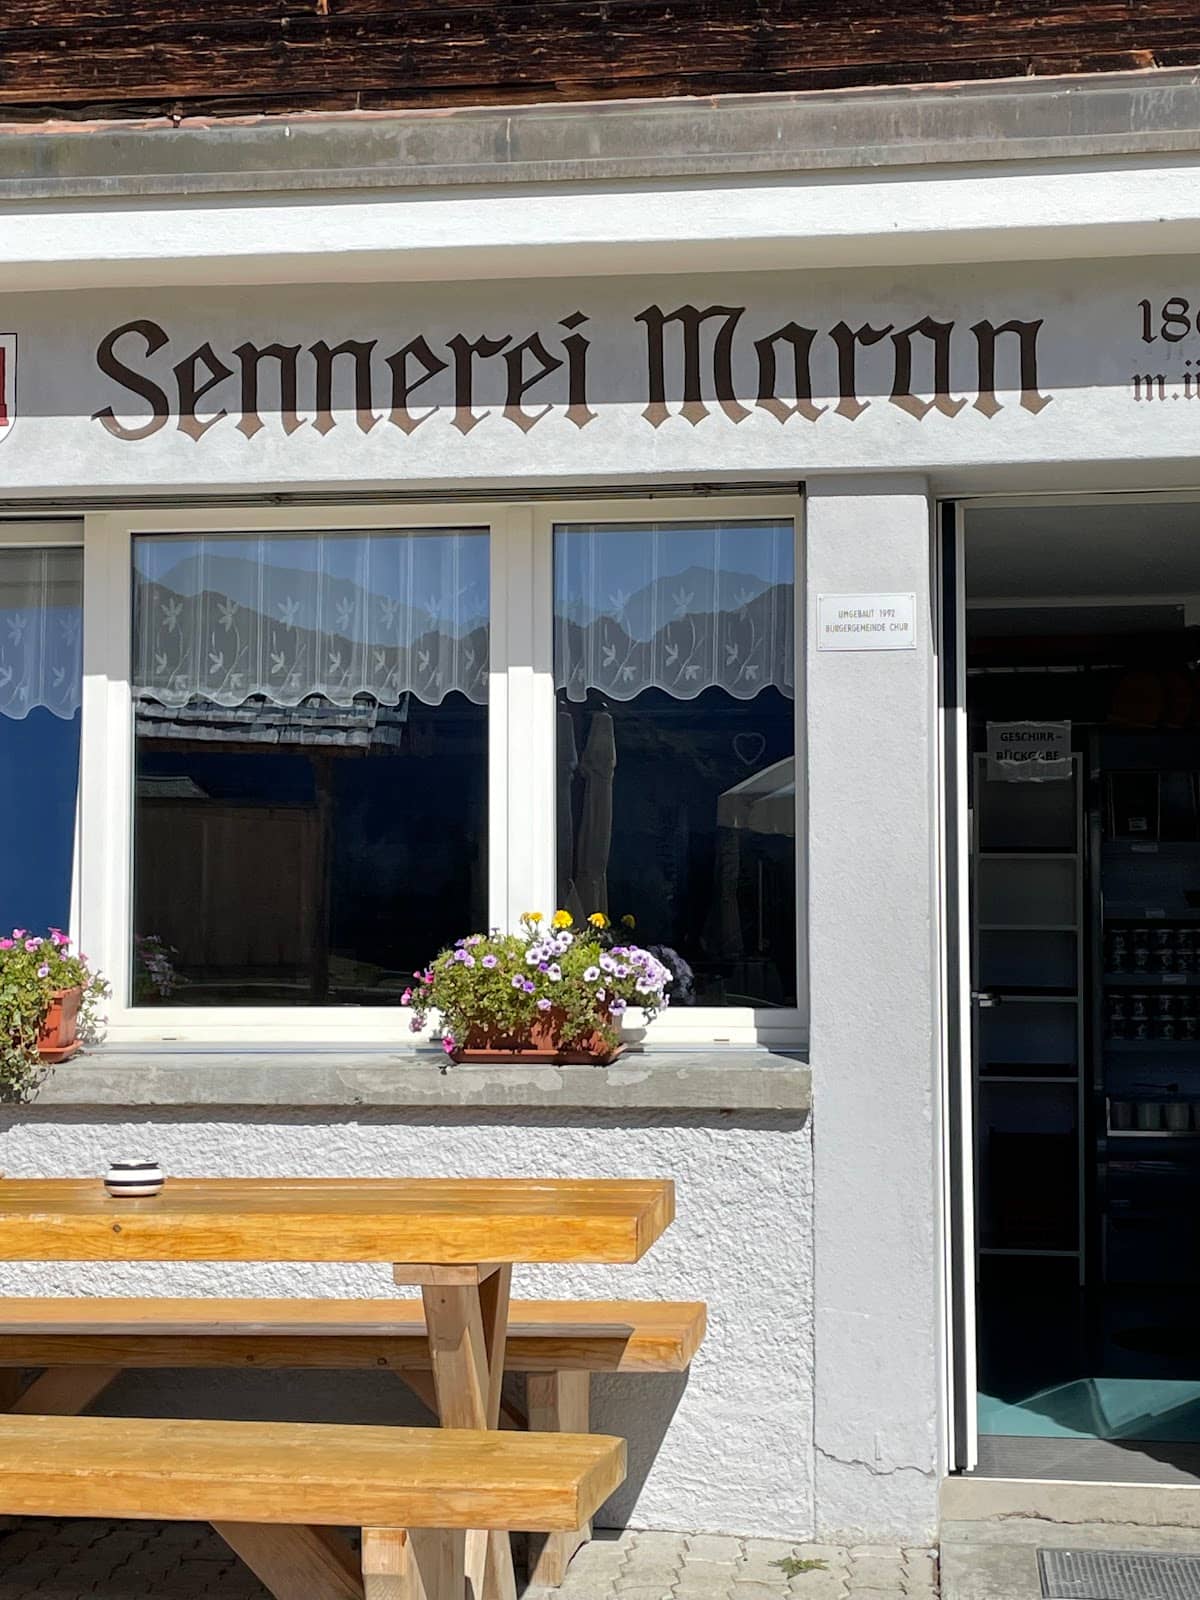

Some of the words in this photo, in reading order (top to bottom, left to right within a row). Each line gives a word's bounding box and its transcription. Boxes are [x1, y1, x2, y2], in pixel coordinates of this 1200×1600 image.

[1137, 297, 1200, 343] 18
[91, 310, 598, 442] Sennerei
[634, 304, 1053, 430] Maran
[838, 609, 874, 619] UMGEBAUT
[879, 609, 896, 618] 1992
[889, 622, 909, 631] CHUR
